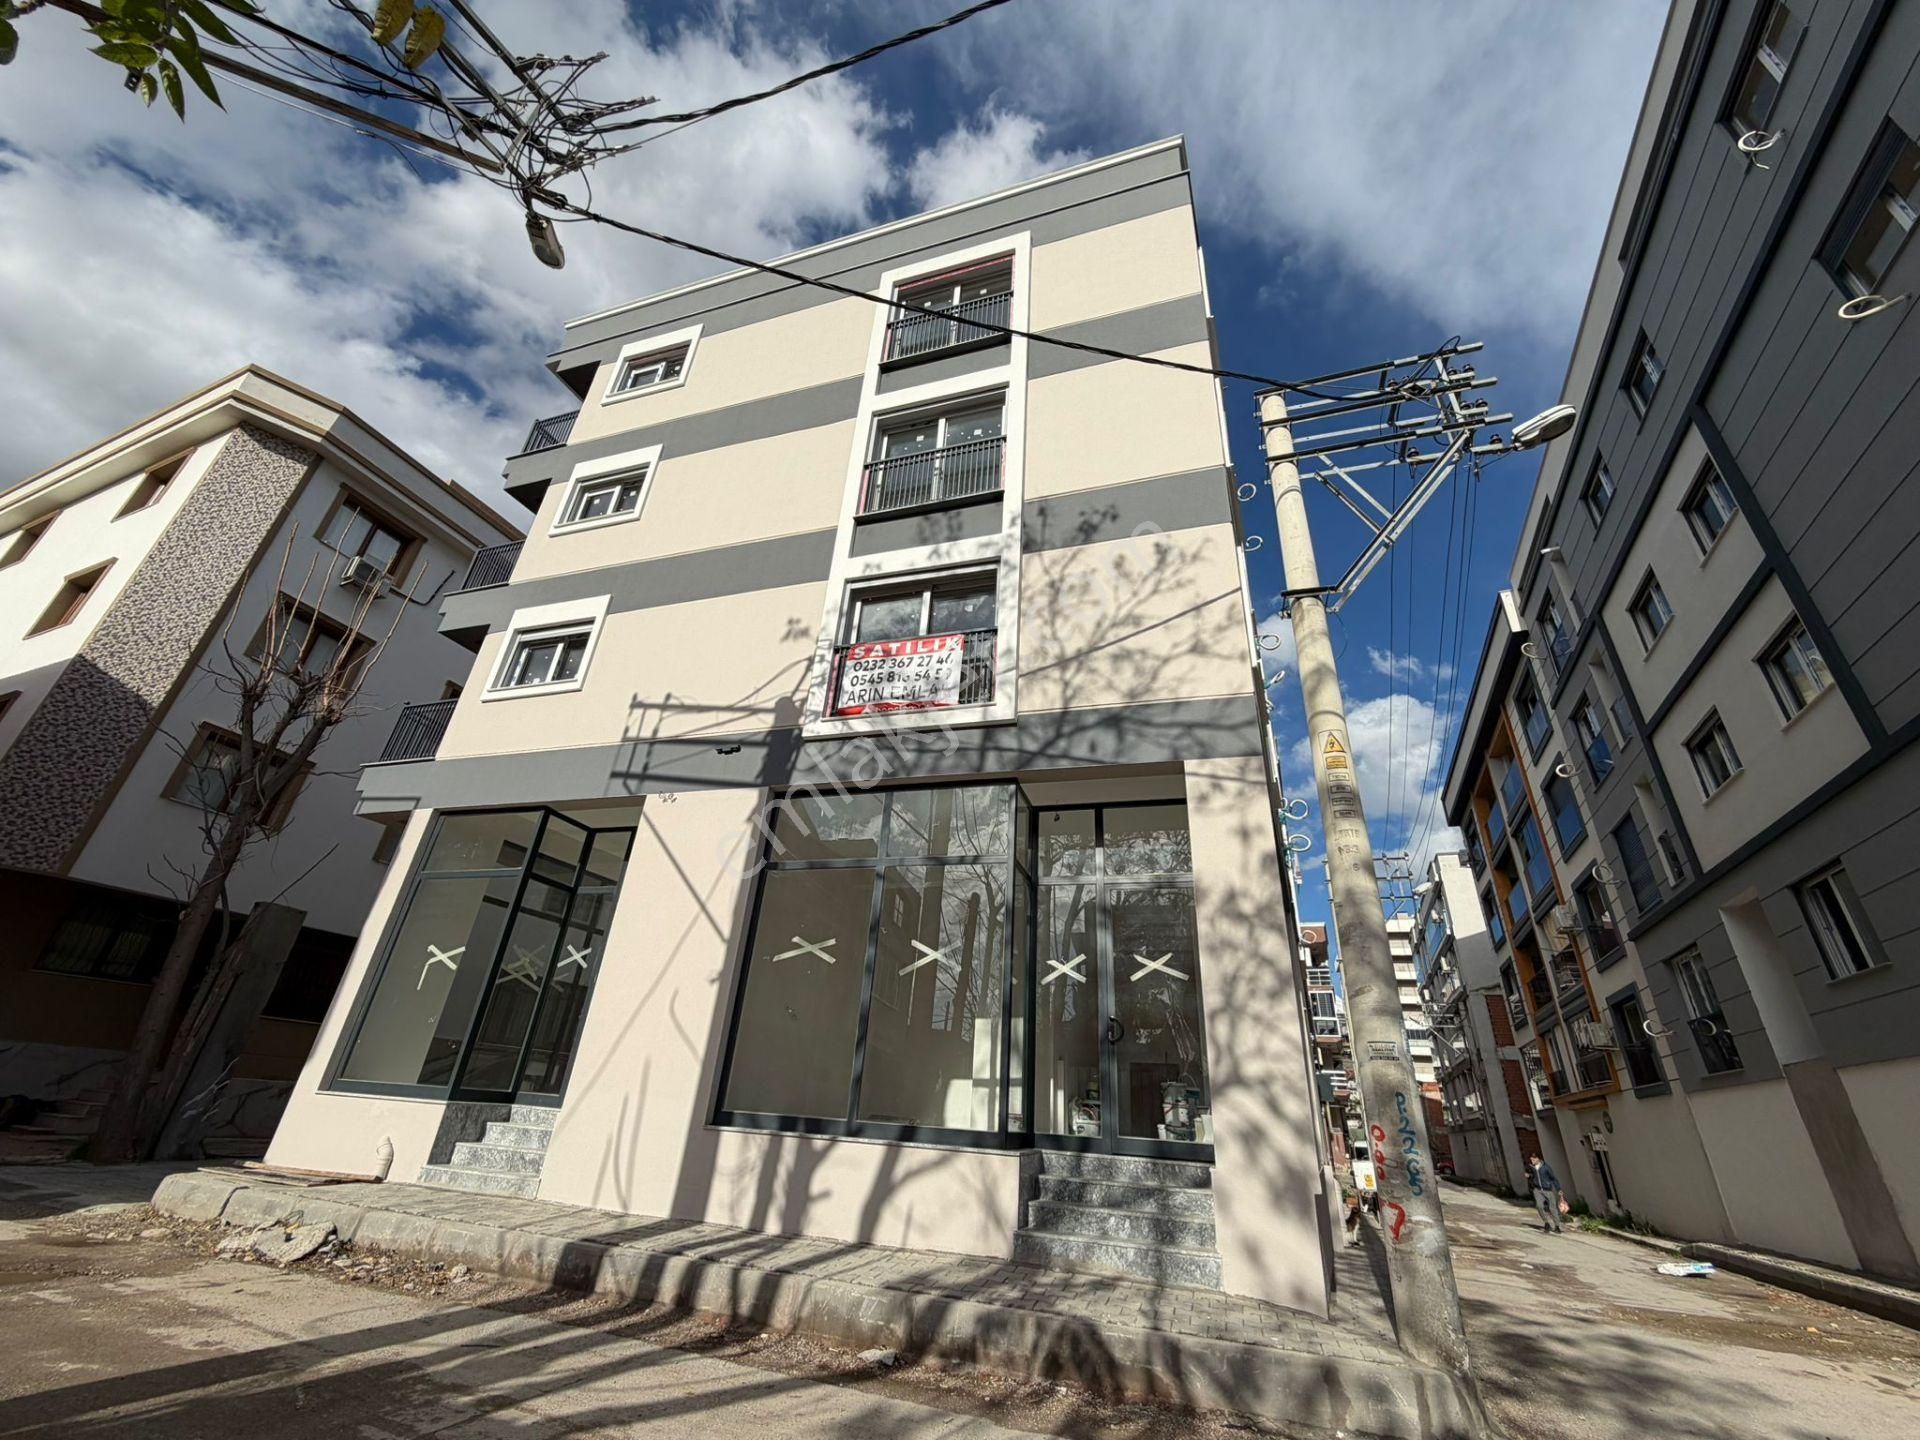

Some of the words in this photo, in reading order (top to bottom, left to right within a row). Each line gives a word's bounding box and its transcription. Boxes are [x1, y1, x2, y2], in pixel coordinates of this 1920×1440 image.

[853, 636, 961, 659] SATILIK
[853, 659, 886, 672] 0232
[889, 656, 914, 669] 367
[917, 655, 933, 667] 27
[850, 671, 884, 687] 0545
[914, 669, 931, 681] 54
[845, 686, 885, 705] ARIN
